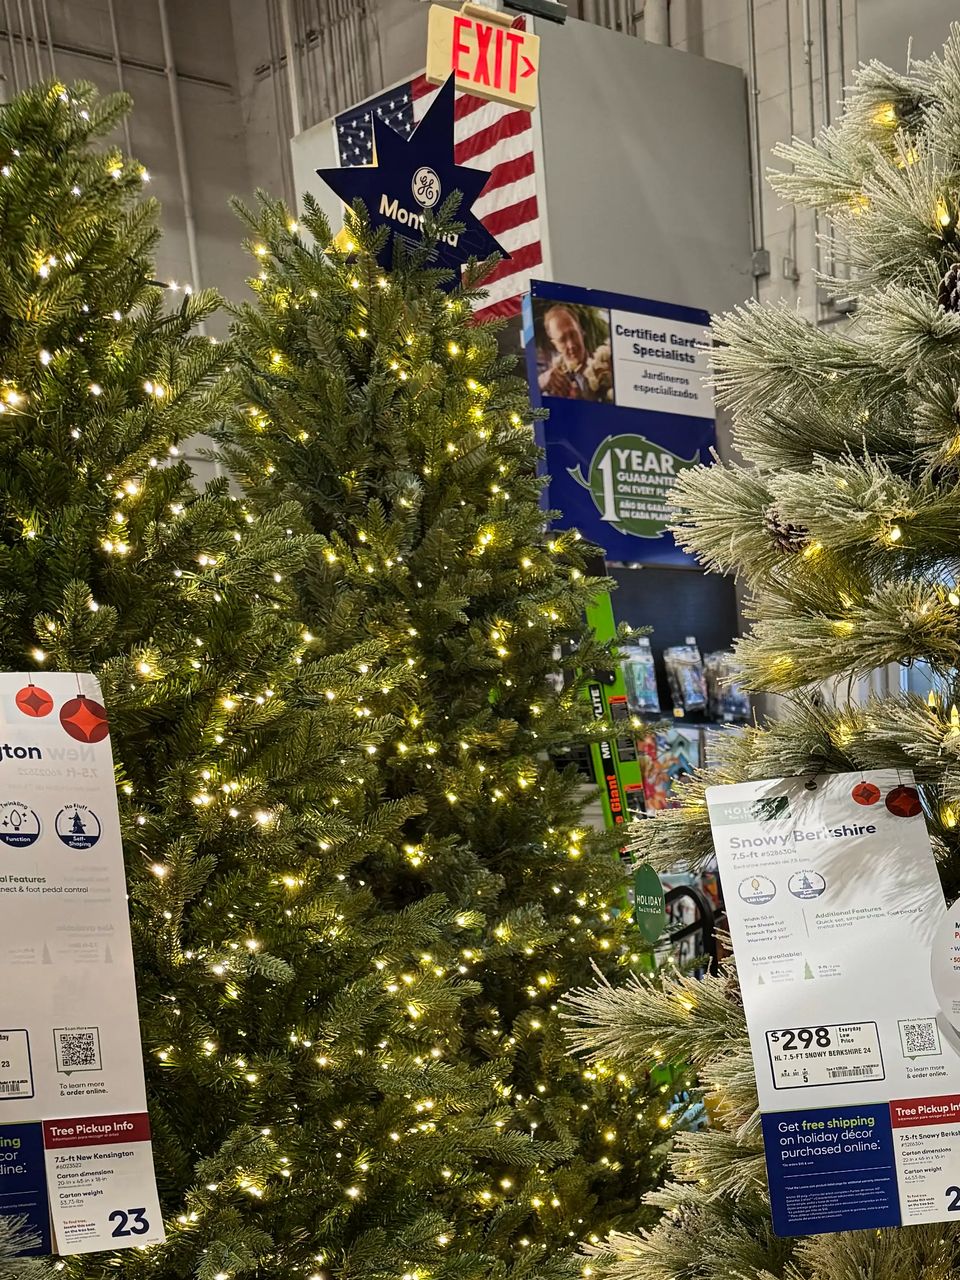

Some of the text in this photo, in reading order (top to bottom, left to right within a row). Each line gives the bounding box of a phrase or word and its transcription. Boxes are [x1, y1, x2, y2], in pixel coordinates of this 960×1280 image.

[452, 15, 524, 94] EXIT
[615, 325, 666, 343] Certified
[633, 343, 695, 363] Specialists
[642, 370, 689, 385] Jardineros
[634, 385, 699, 400] especializados
[614, 448, 675, 475] YEAR
[598, 449, 621, 521] 1
[617, 484, 655, 494] ON EVERY
[607, 775, 622, 813] Giant
[729, 823, 877, 850] Snowy Berkshire
[731, 851, 758, 860] 7.5-ft
[9, 875, 46, 883] Features
[42, 886, 63, 894] pedal
[636, 895, 662, 906] HOLIDAY
[770, 1027, 831, 1051] $298
[829, 1048, 861, 1057] BERKSHIRE
[1, 1060, 10, 1068] 23
[914, 1065, 930, 1073] learn
[804, 1075, 808, 1083] 5
[895, 1107, 916, 1116] Tree
[918, 1104, 949, 1115] Pickup
[50, 1121, 134, 1136] Tree Pickup Info
[778, 1116, 875, 1132] Get free shipping
[780, 1130, 872, 1145] on holiday décor
[93, 1151, 134, 1159] Kensington
[782, 1144, 841, 1160] purchased
[922, 1147, 951, 1155] dimensions
[80, 1169, 113, 1177] dimensions
[108, 1208, 150, 1238] 23
